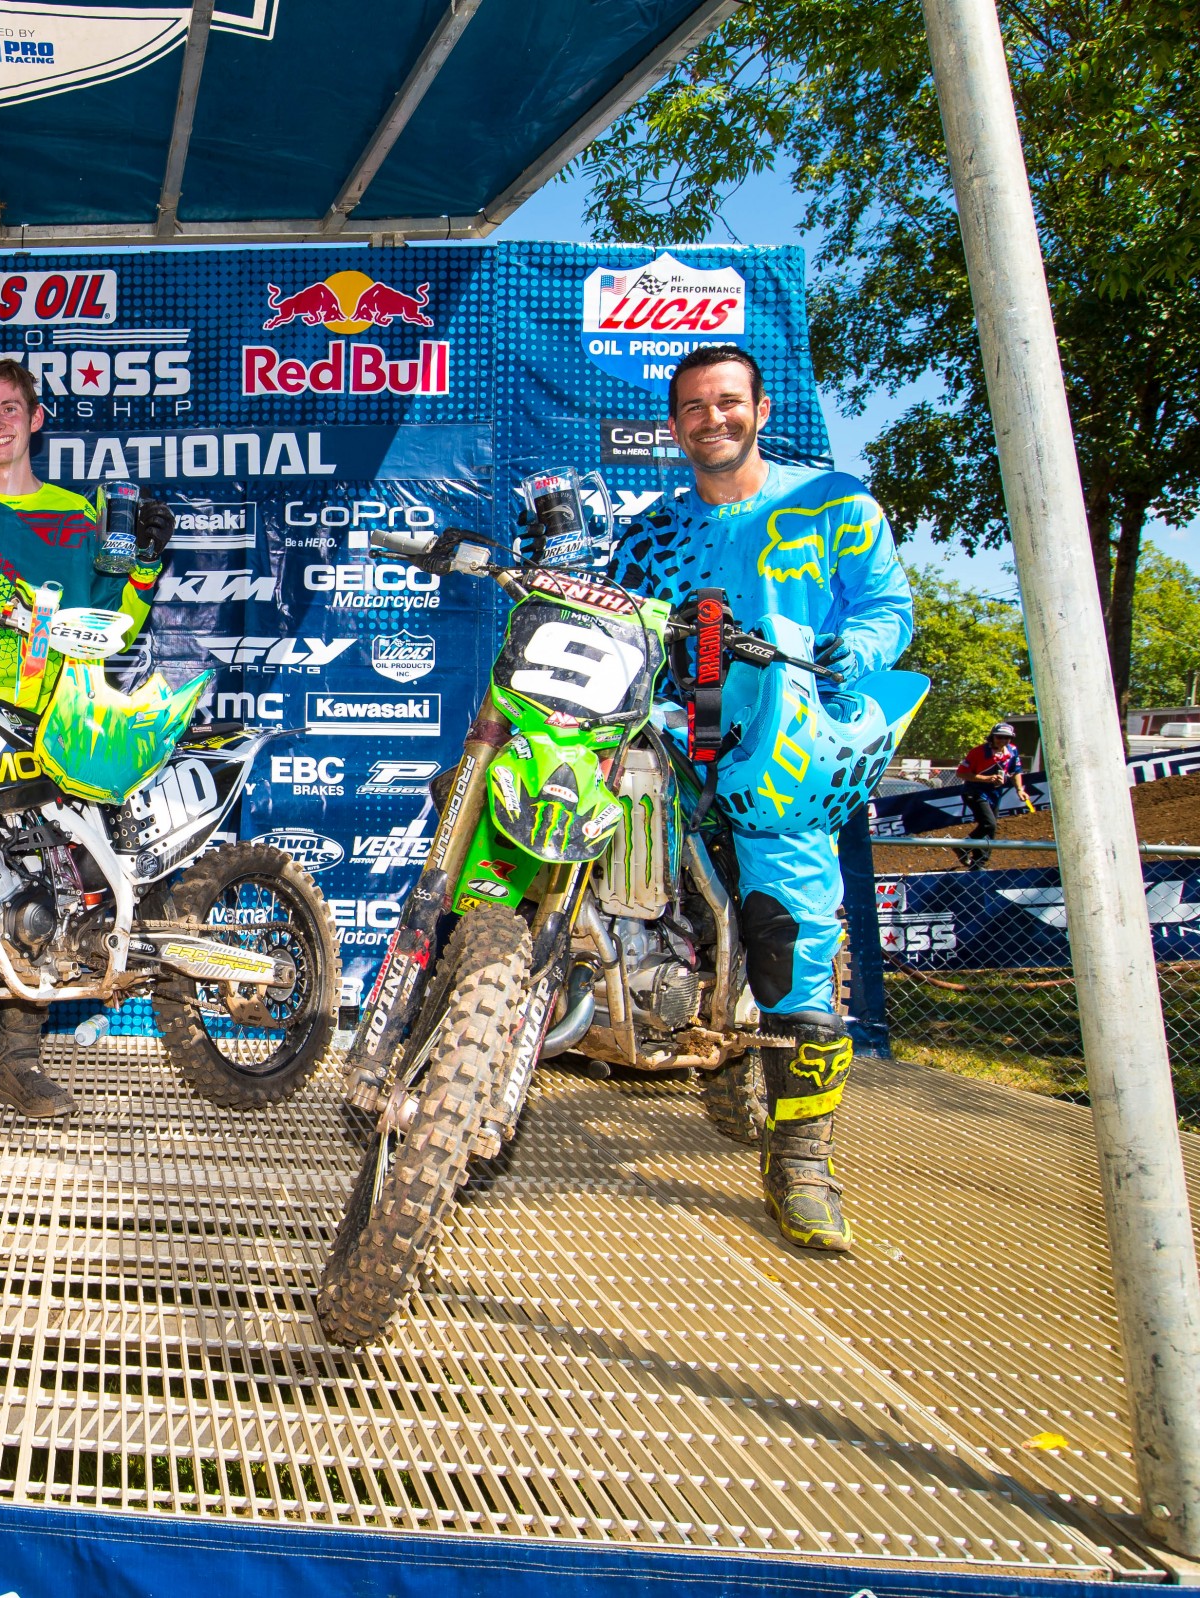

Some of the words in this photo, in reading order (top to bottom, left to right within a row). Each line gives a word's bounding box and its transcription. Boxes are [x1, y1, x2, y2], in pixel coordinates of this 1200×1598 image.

[18, 29, 36, 38] BY
[3, 40, 55, 57] PRO
[5, 56, 55, 65] RACING
[34, 273, 108, 320] OIL
[670, 285, 742, 295] PERFORMANCE
[600, 298, 740, 331] LUCAS
[588, 340, 624, 356] OIL
[241, 341, 344, 396] Red
[349, 339, 450, 396] Bull
[48, 430, 337, 480] NATIONAL
[627, 447, 651, 456] HERO.
[534, 476, 559, 490] 2ND
[284, 501, 435, 528] GoPro
[718, 502, 754, 519] FOX
[102, 541, 136, 552] DREAM
[284, 537, 297, 547] Be
[304, 536, 338, 548] HERO.
[542, 542, 583, 561] DREAM
[110, 548, 131, 556] RACE
[550, 553, 577, 564] RACE
[152, 569, 278, 601] KTM
[332, 591, 441, 610] Motorcycle
[530, 574, 648, 616] RENTHA
[50, 621, 110, 644] CERBIS
[379, 646, 433, 660] LUCAS
[698, 623, 721, 685] DRAGON
[736, 642, 776, 659] ARC
[229, 665, 322, 674] RACING
[509, 621, 646, 715] 9
[316, 698, 430, 719] Kawasaki
[757, 688, 818, 818] FOX
[271, 755, 345, 785] EBC
[454, 754, 476, 796] PRO
[293, 785, 345, 796] BRAKES
[434, 796, 463, 870] CIRCUIT
[263, 836, 325, 850] Pivot
[349, 857, 376, 865] PISTON
[327, 898, 402, 929] EIC
[164, 943, 205, 963] PRO
[207, 952, 274, 974] CIRCUIT
[364, 953, 411, 1056] UNLOP
[502, 976, 550, 1113] DUNLOP
